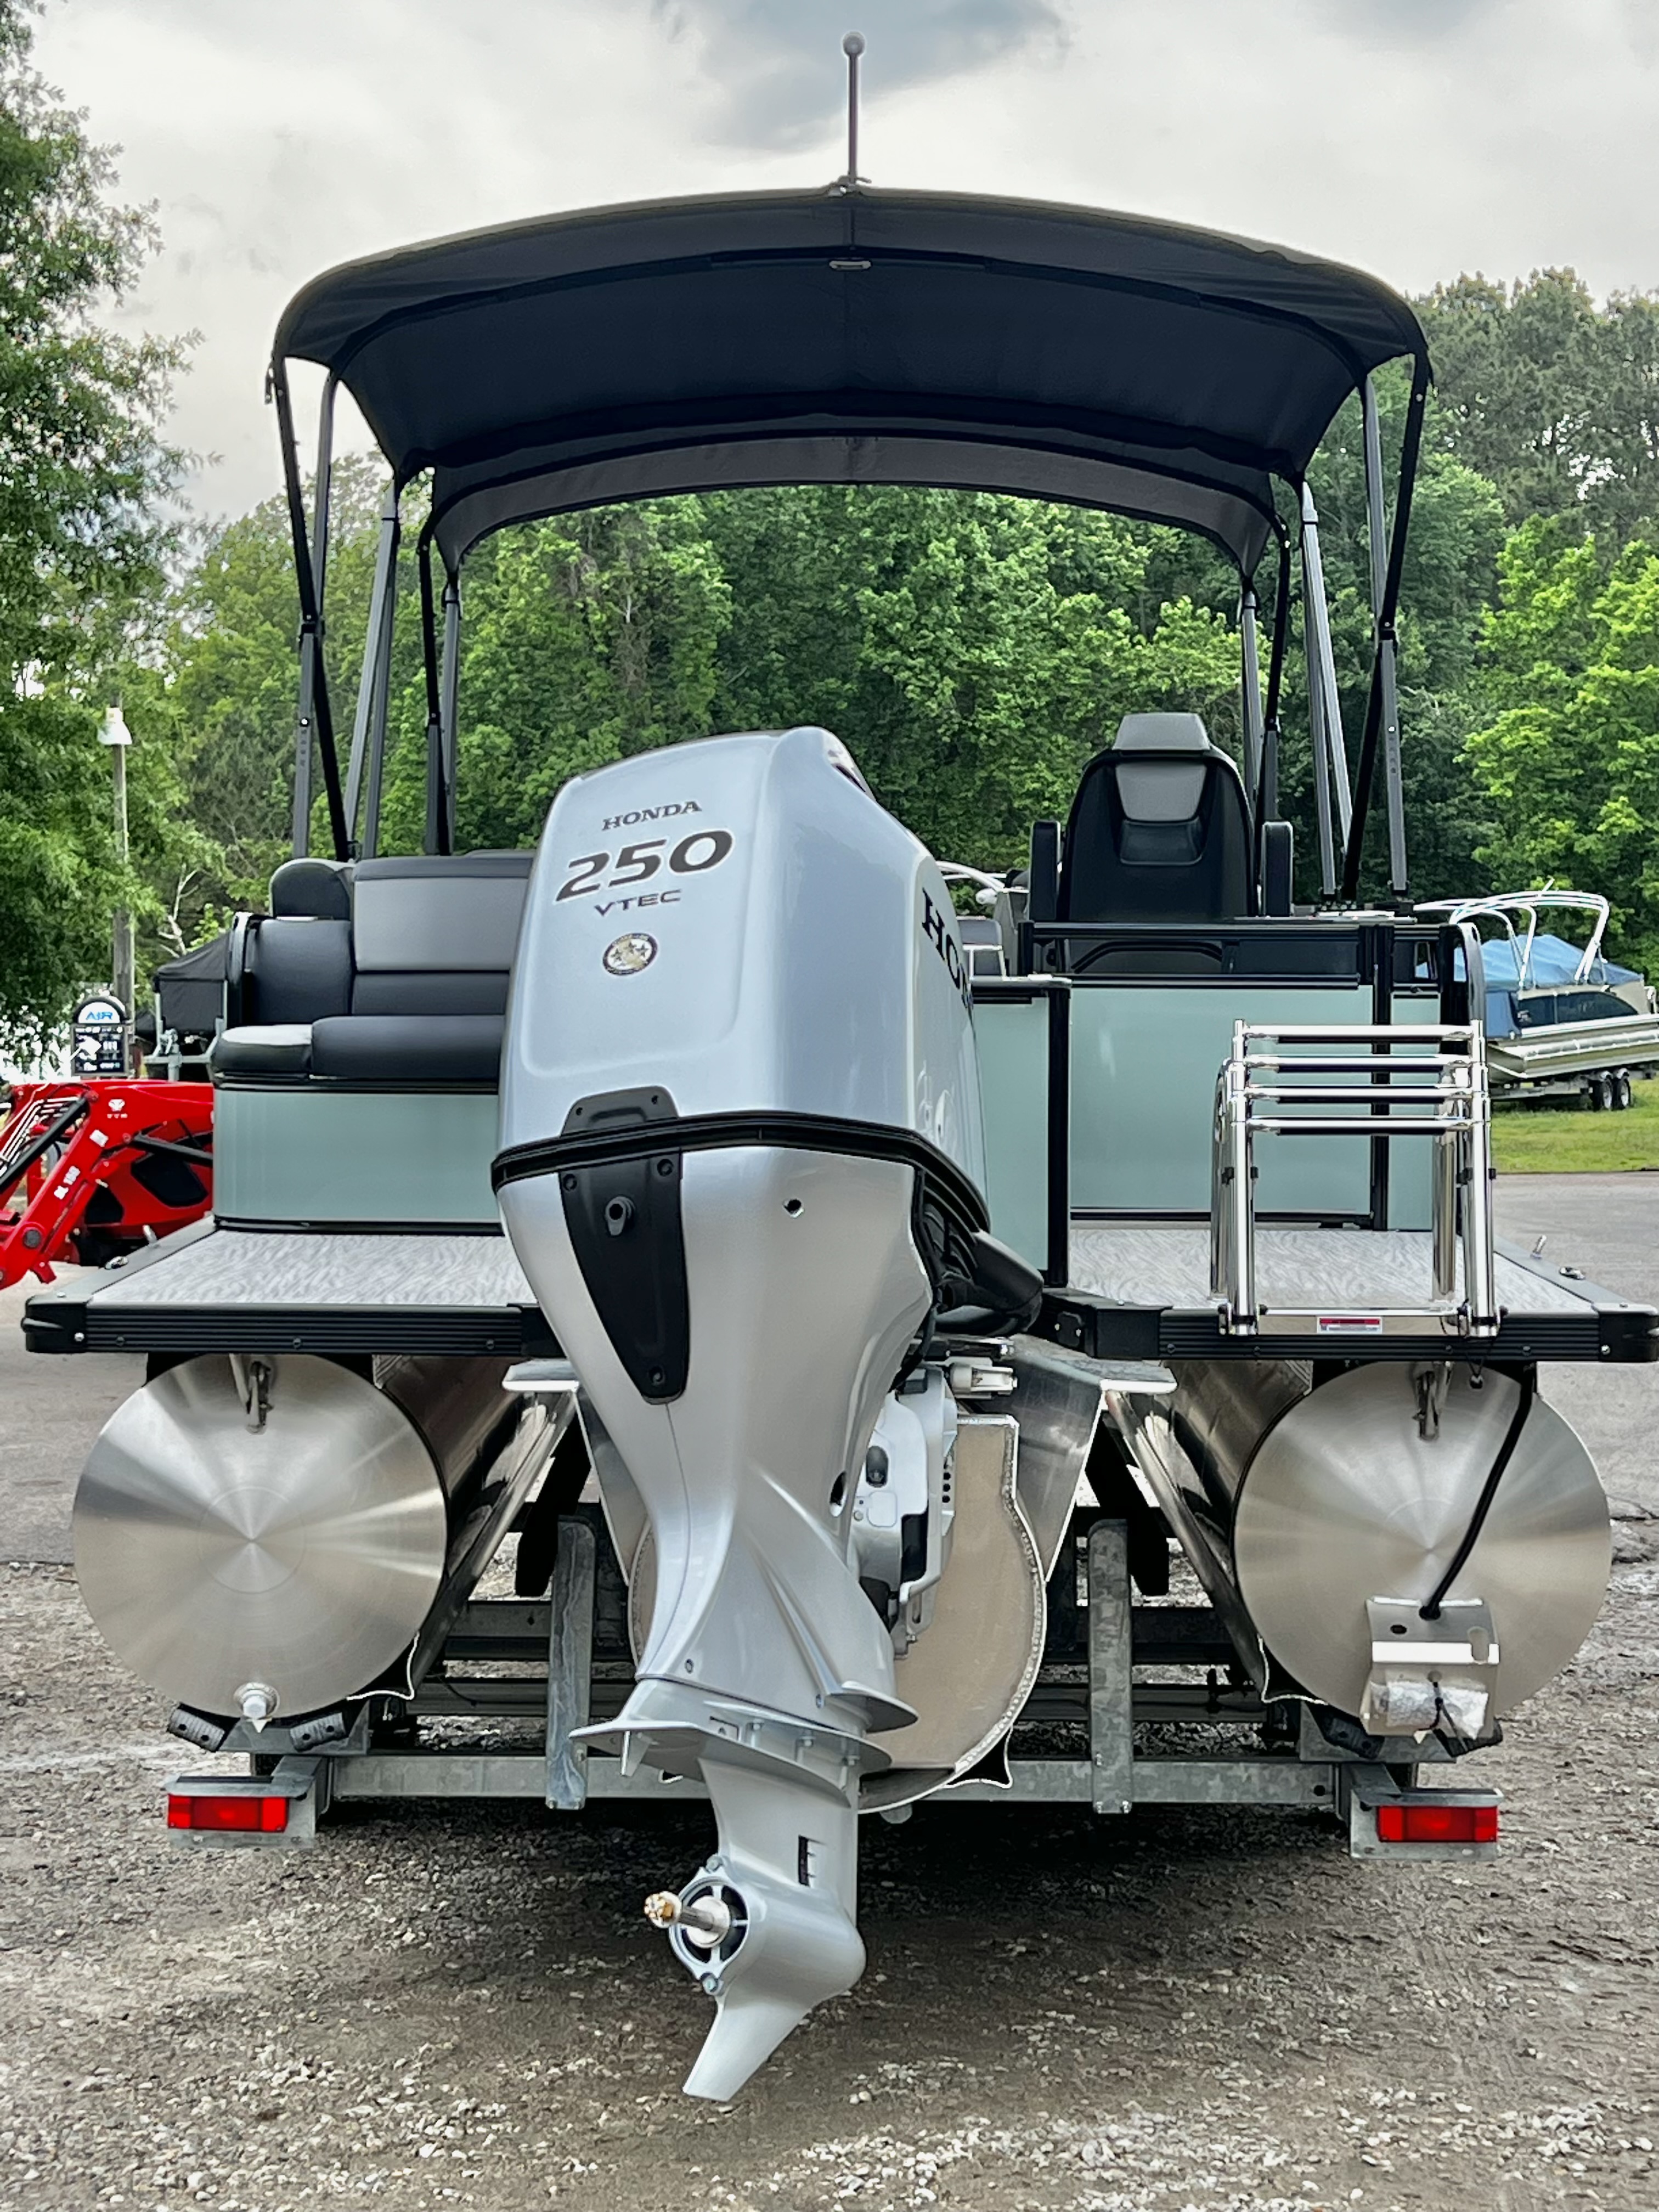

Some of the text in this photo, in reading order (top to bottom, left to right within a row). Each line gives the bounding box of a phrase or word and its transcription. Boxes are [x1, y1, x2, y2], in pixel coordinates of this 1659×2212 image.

[602, 801, 702, 831] HONDA
[556, 830, 733, 902] 250
[594, 889, 681, 917] VTEC
[922, 888, 973, 1009] HON
[86, 1012, 113, 1020] AIR
